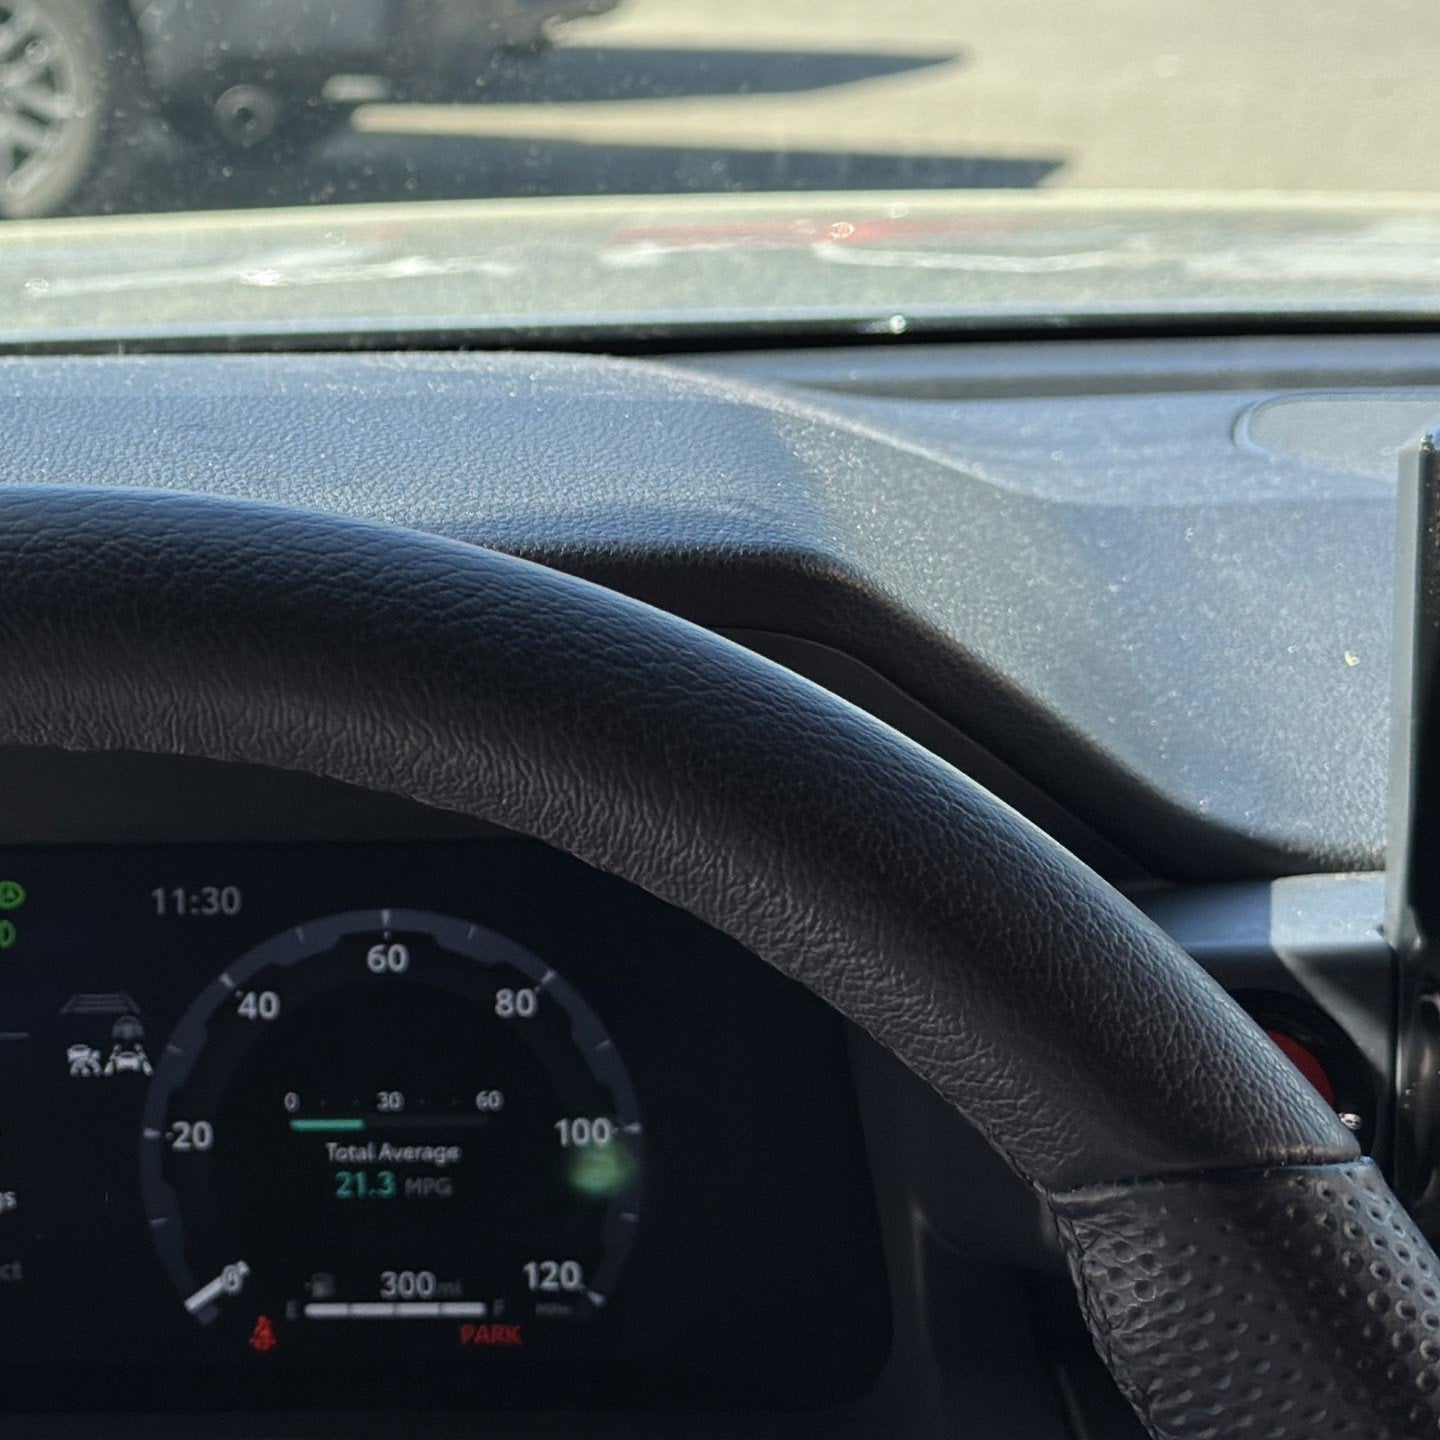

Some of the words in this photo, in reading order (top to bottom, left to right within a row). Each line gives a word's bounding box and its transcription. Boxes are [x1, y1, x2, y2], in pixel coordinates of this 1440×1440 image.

[150, 886, 242, 915] 11:30
[367, 945, 409, 972] 60
[237, 991, 280, 1020] 40
[494, 989, 536, 1018] 80
[284, 1093, 300, 1112] 0
[376, 1091, 404, 1111] 30
[476, 1090, 504, 1112] 60
[172, 1121, 214, 1150] 20
[554, 1118, 612, 1146] 100
[325, 1142, 375, 1162] Total
[377, 1142, 461, 1167] Average
[335, 1171, 396, 1199] 21.3
[380, 1270, 437, 1299] 300
[523, 1260, 581, 1291] 120
[460, 1324, 522, 1346] PARK
